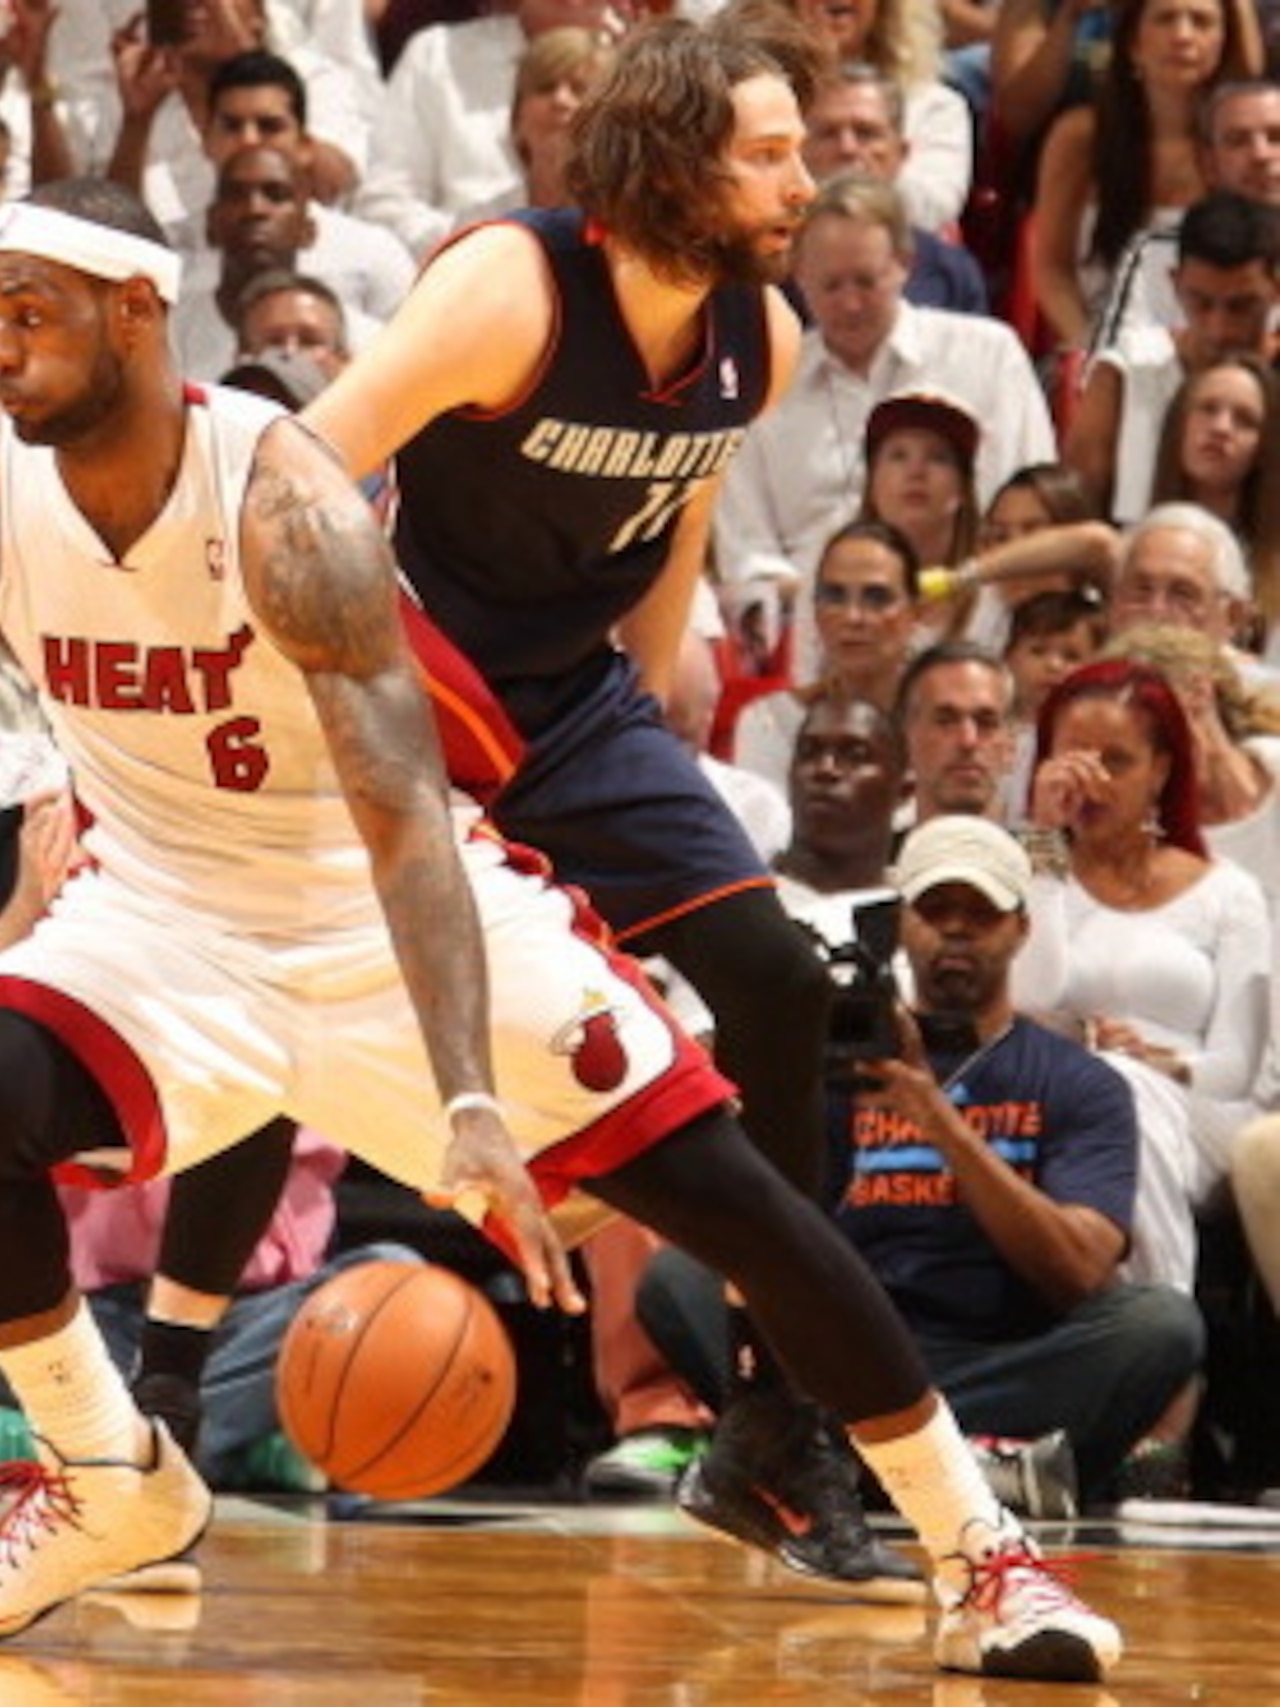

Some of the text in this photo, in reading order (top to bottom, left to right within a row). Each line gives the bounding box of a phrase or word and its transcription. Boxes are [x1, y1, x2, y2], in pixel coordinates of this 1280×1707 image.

[42, 622, 255, 716] HEAT
[206, 716, 270, 792] 6
[853, 1101, 1043, 1146] CHAOTTE
[850, 1172, 956, 1207] BASKE
